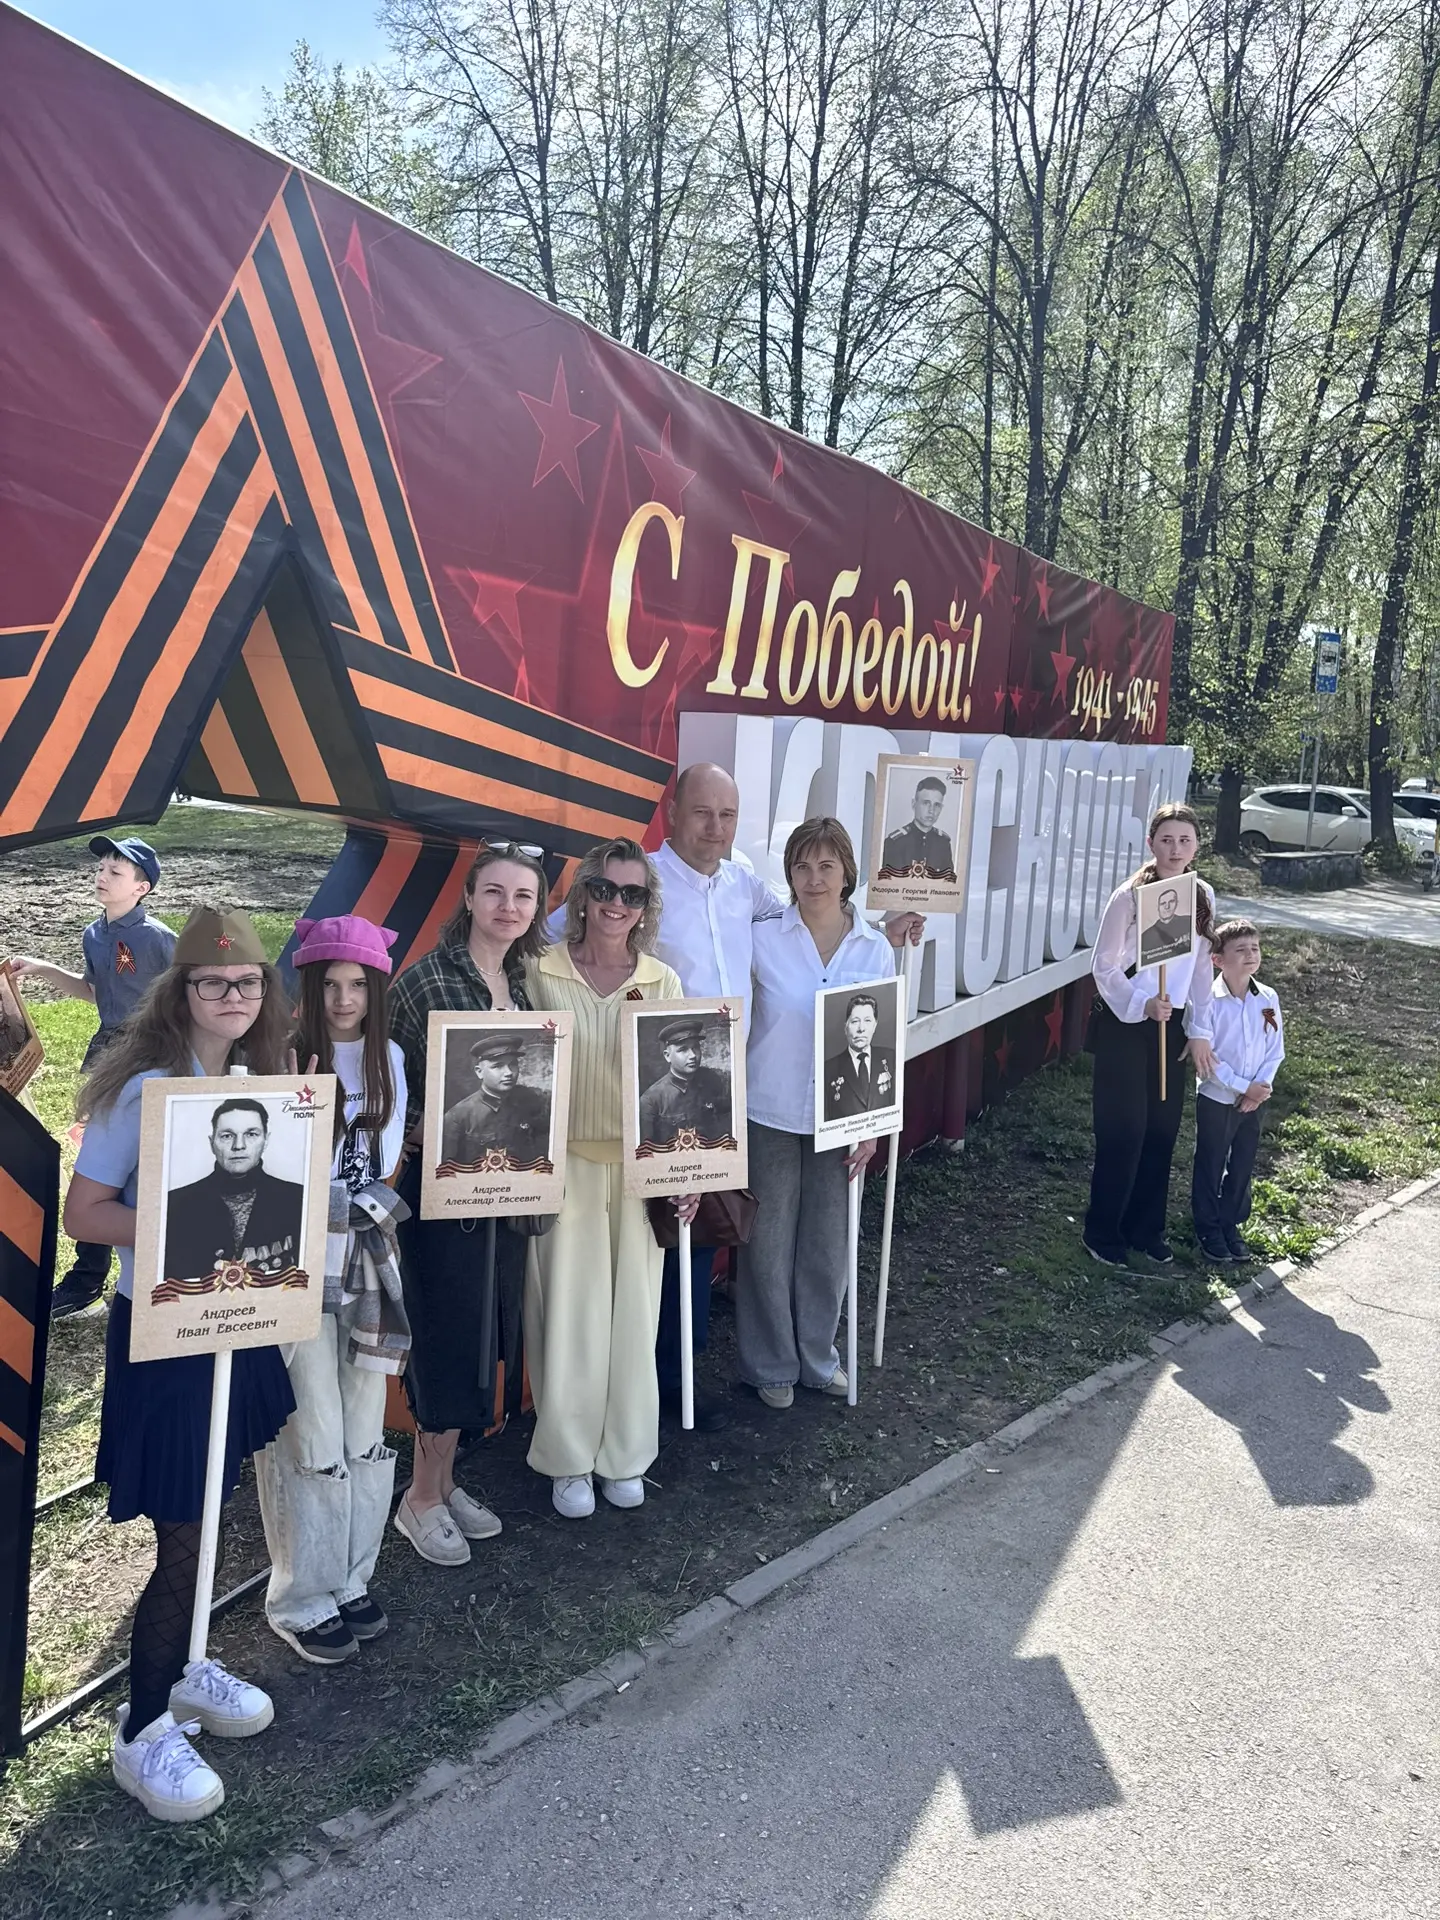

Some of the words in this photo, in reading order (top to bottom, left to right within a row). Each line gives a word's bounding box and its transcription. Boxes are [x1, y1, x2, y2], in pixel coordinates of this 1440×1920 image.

[607, 501, 685, 688] С
[706, 534, 983, 722] Победой!
[668, 1164, 702, 1173] Андреев
[645, 1175, 688, 1185] Александр
[692, 1171, 728, 1181] Евсеевич
[472, 1185, 511, 1195] Андреев
[444, 1196, 494, 1206] Александр
[498, 1194, 541, 1204] Евсеевич
[200, 1306, 256, 1320] Андреев
[176, 1327, 210, 1339] Иван
[216, 1318, 278, 1334] Евсеевич
